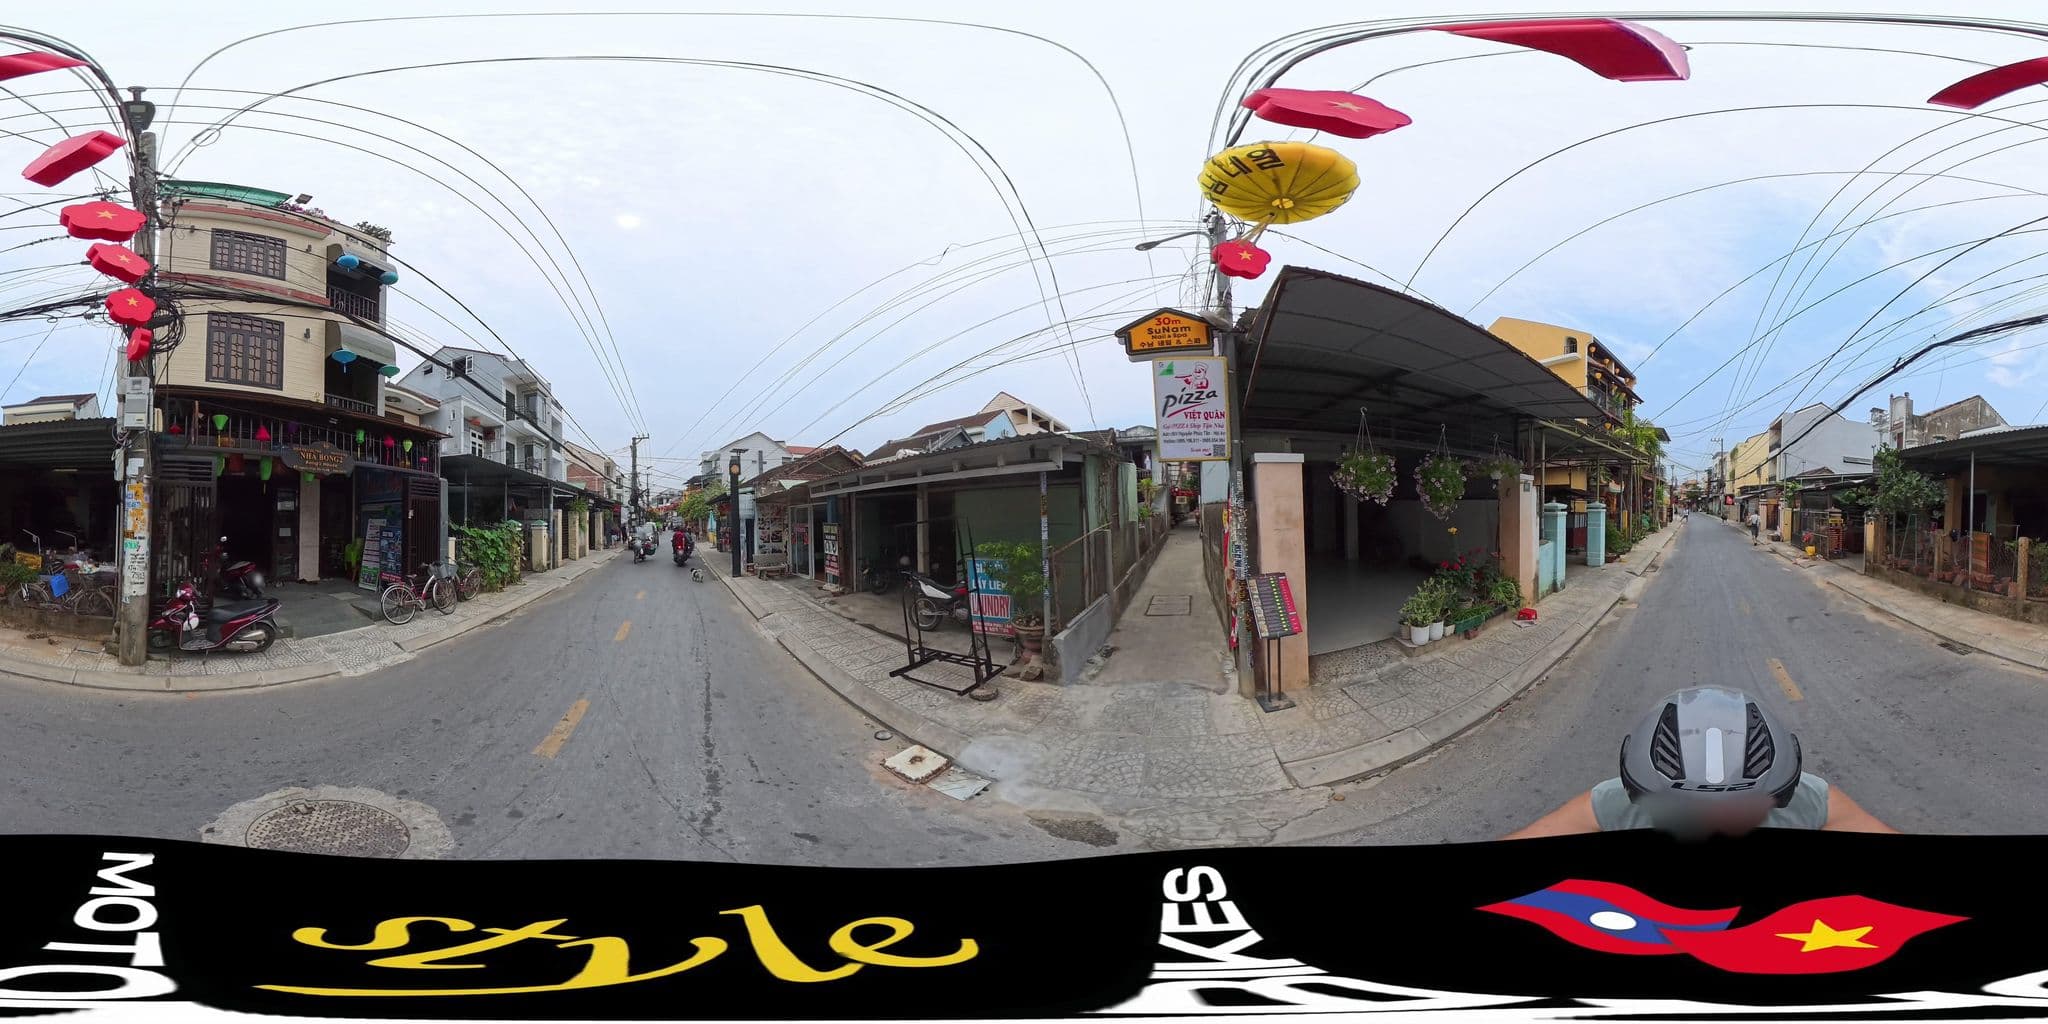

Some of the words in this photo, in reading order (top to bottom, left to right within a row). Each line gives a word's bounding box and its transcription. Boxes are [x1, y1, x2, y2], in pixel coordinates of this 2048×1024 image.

[1155, 317, 1181, 326] 30m
[1147, 326, 1191, 335] SuNam
[1671, 781, 1757, 793] LS2
